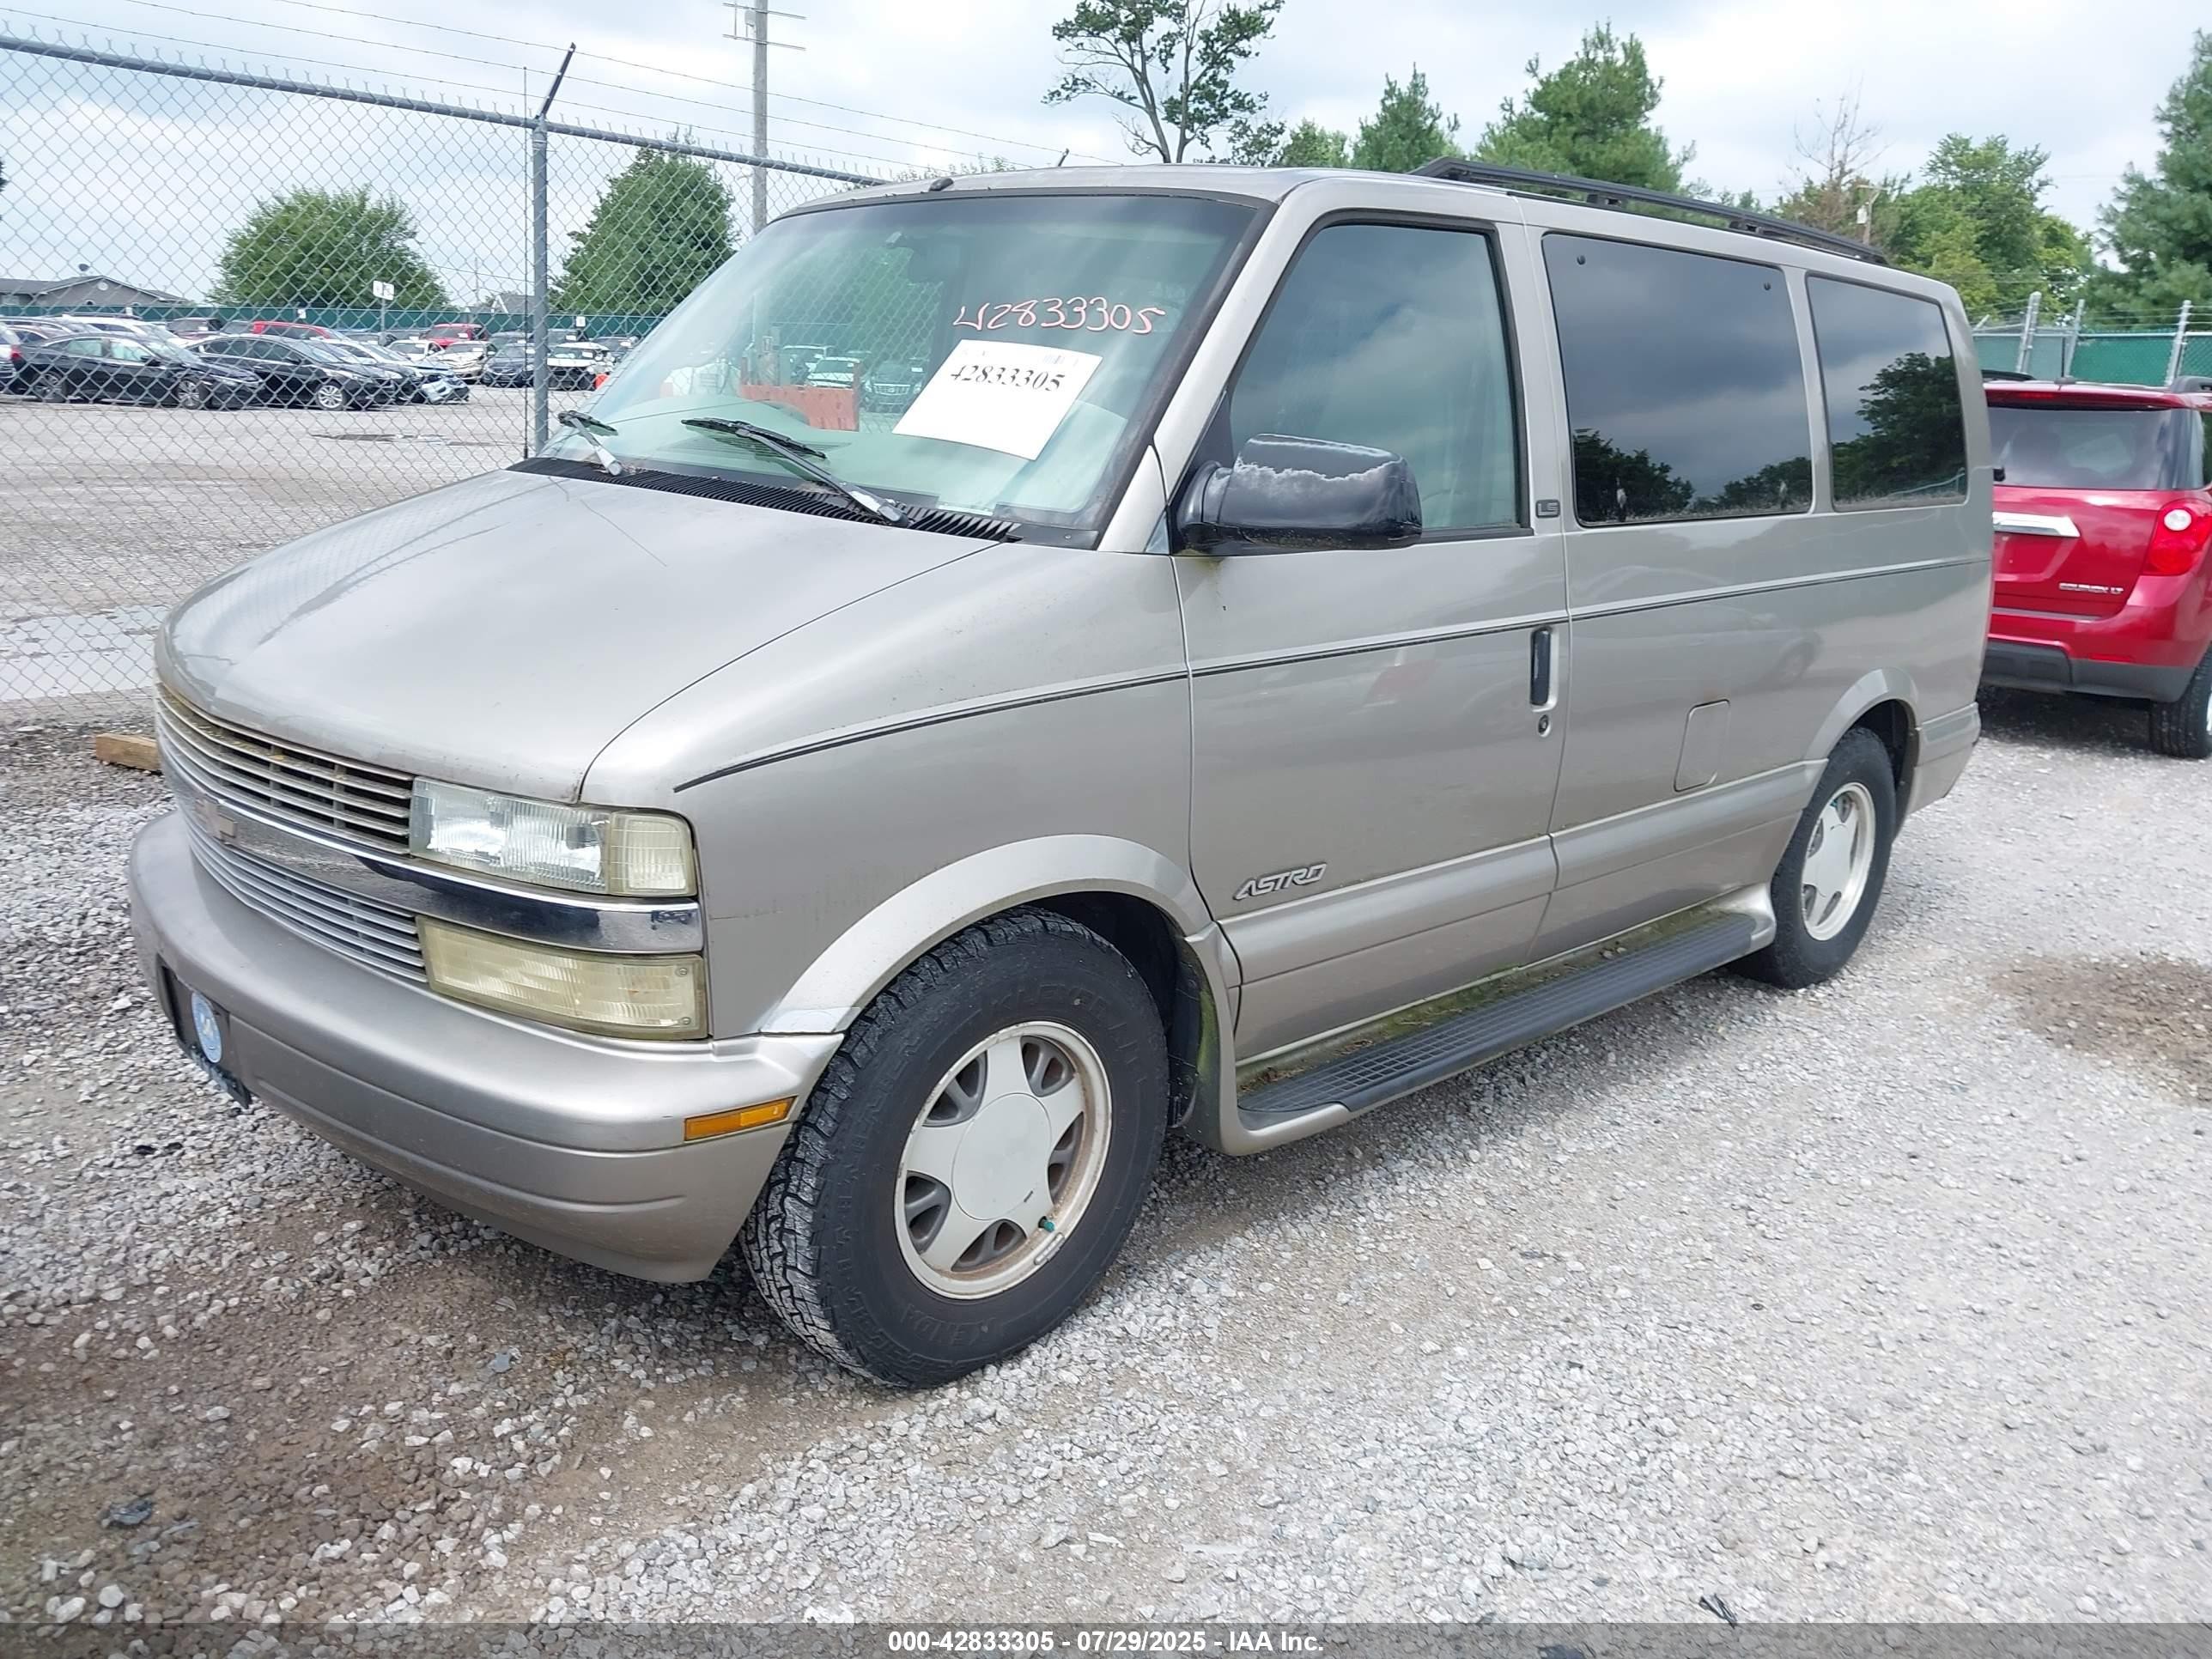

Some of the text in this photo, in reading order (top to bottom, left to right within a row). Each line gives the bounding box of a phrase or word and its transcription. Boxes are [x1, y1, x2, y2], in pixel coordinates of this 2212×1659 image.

[953, 296, 1166, 334] 42833305
[951, 364, 1066, 392] 42833305
[1537, 501, 1559, 517] LS
[1233, 862, 1328, 901] ASTRO
